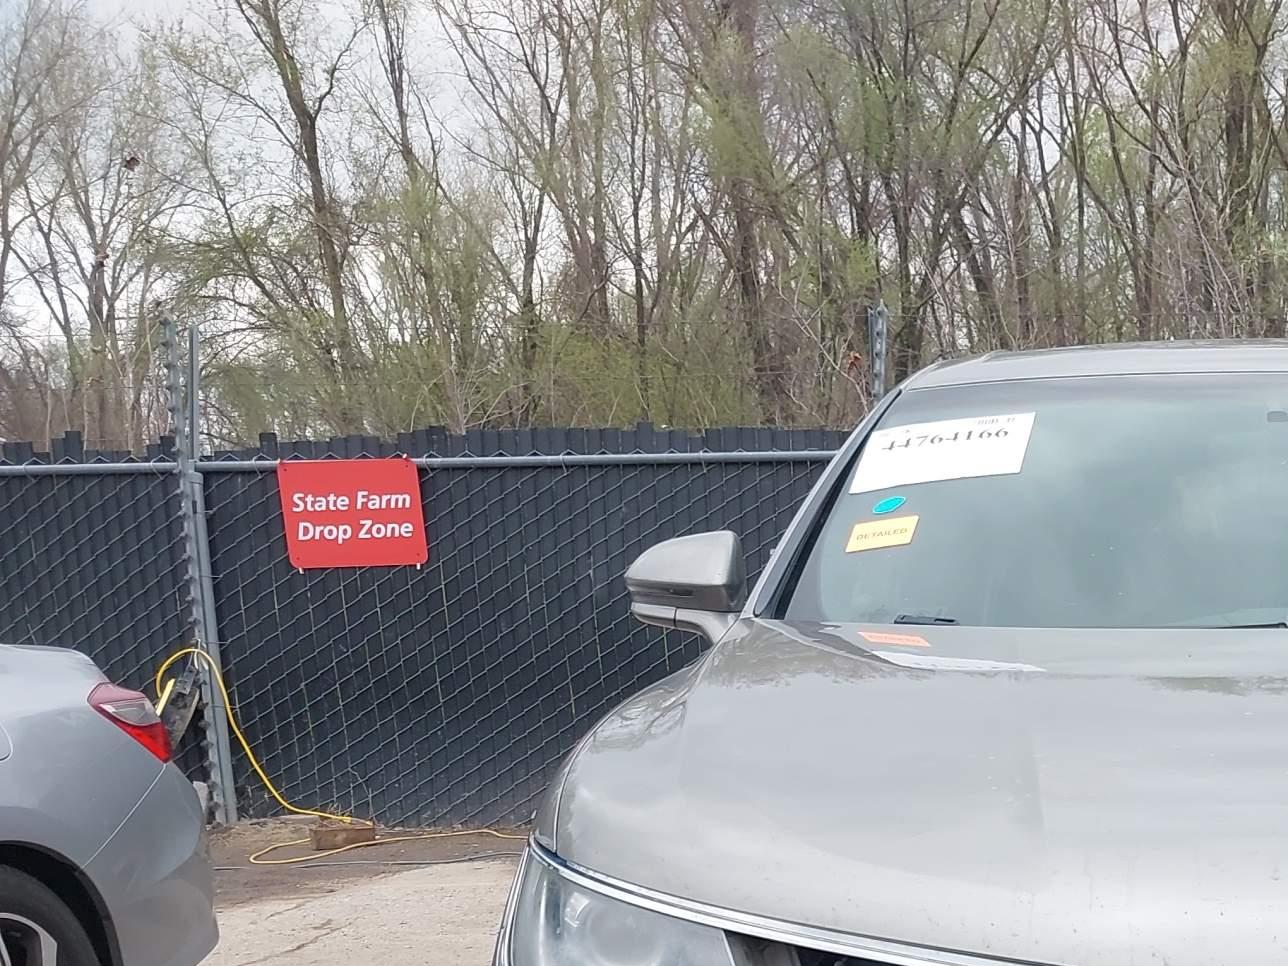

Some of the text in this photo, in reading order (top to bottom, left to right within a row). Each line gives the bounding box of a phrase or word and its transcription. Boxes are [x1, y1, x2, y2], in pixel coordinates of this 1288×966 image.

[881, 428, 1009, 450] 44764166
[292, 491, 411, 512] State Farm
[298, 520, 413, 544] Drop Zone
